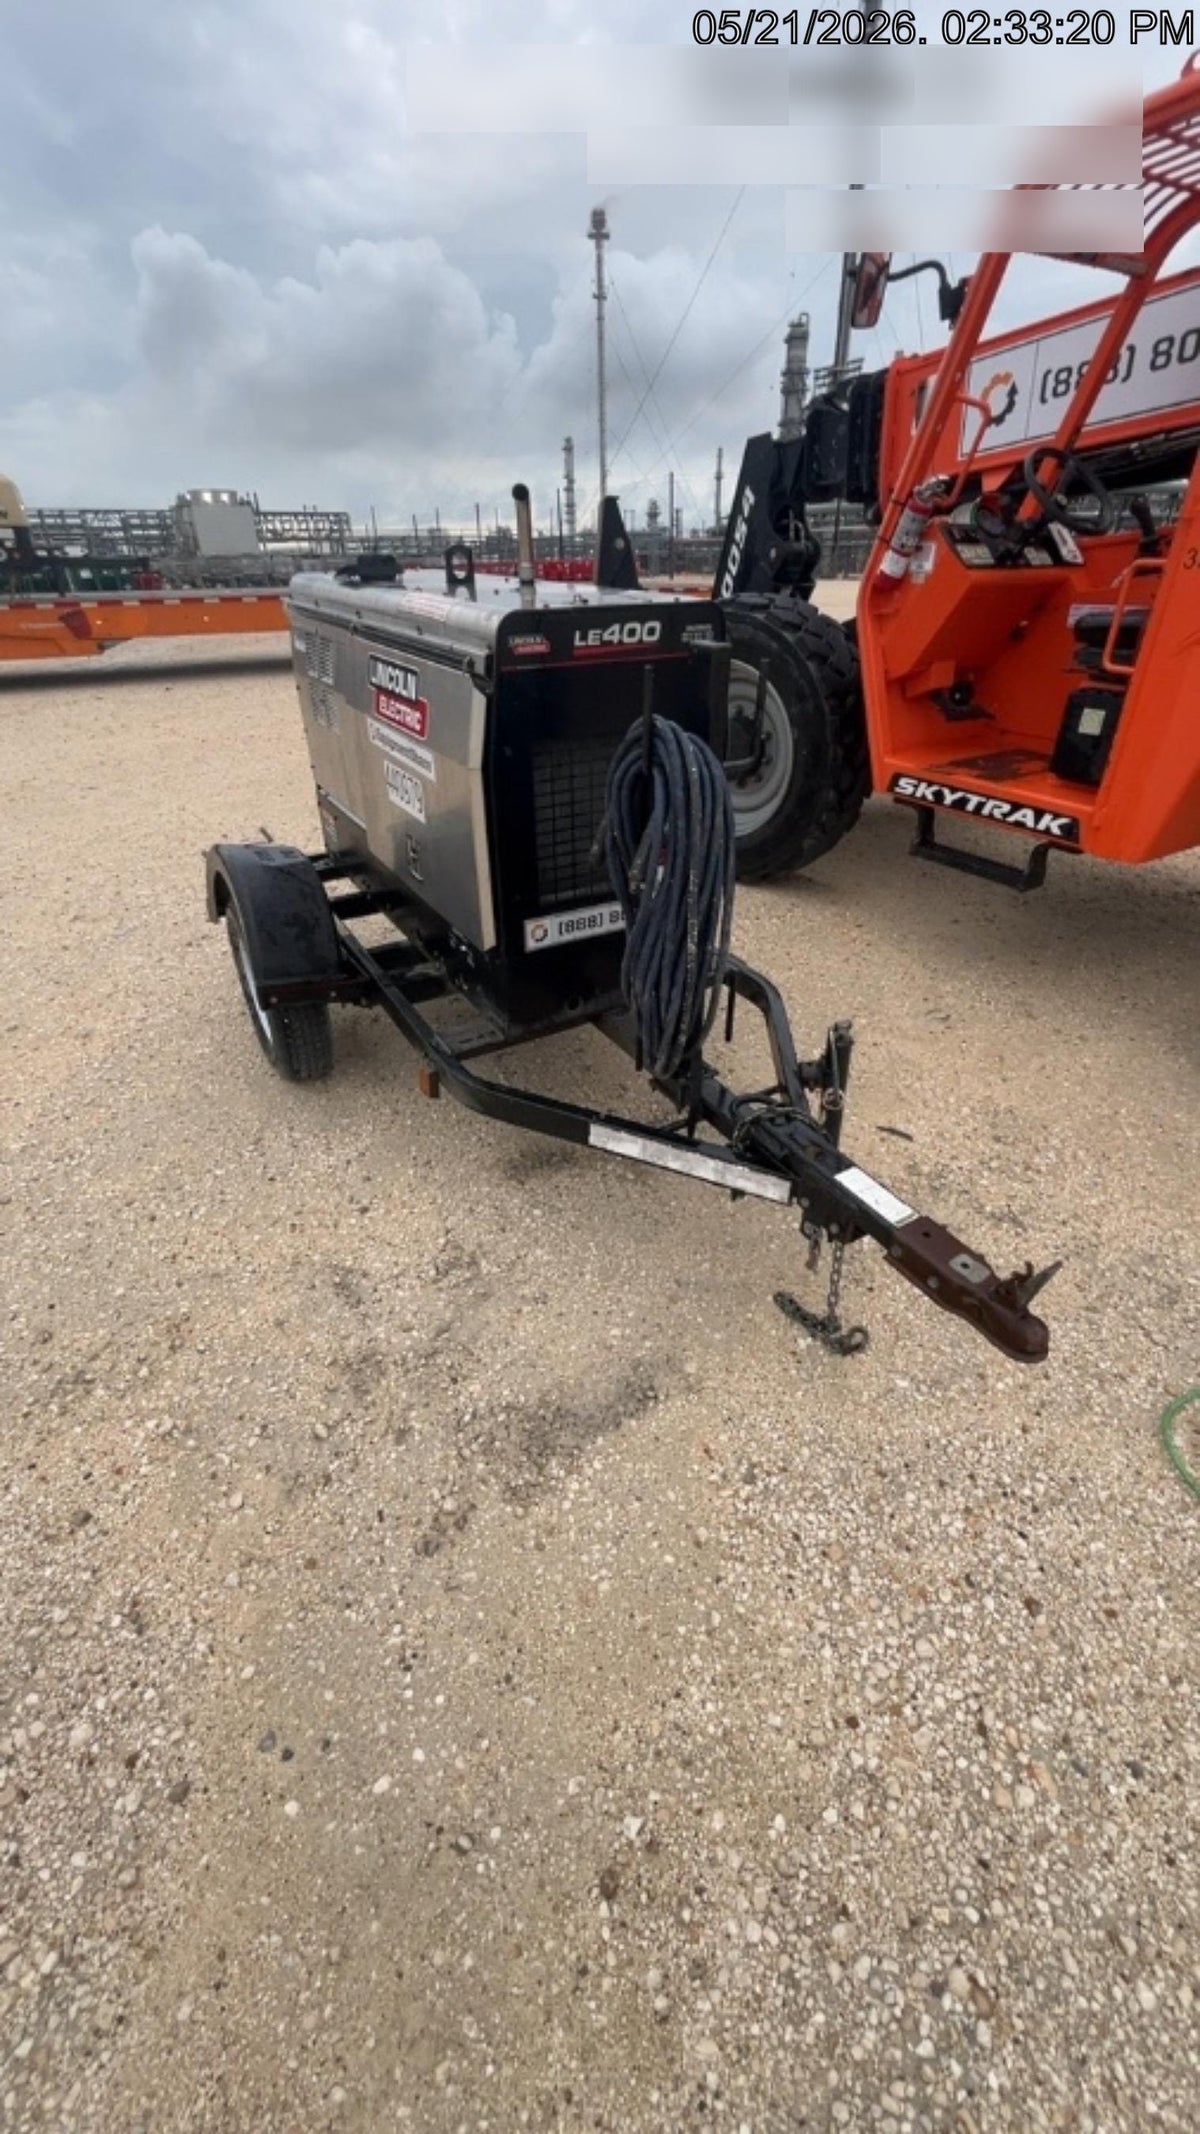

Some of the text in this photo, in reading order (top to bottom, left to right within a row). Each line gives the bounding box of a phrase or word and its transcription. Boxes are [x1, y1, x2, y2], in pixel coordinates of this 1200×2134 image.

[1183, 546, 1200, 571] 3
[573, 620, 662, 647] LE400
[370, 660, 418, 701] LINCOLN
[378, 692, 422, 732] ELECTRIC
[894, 780, 1073, 836] SKYTRAK
[609, 910, 626, 925] 8
